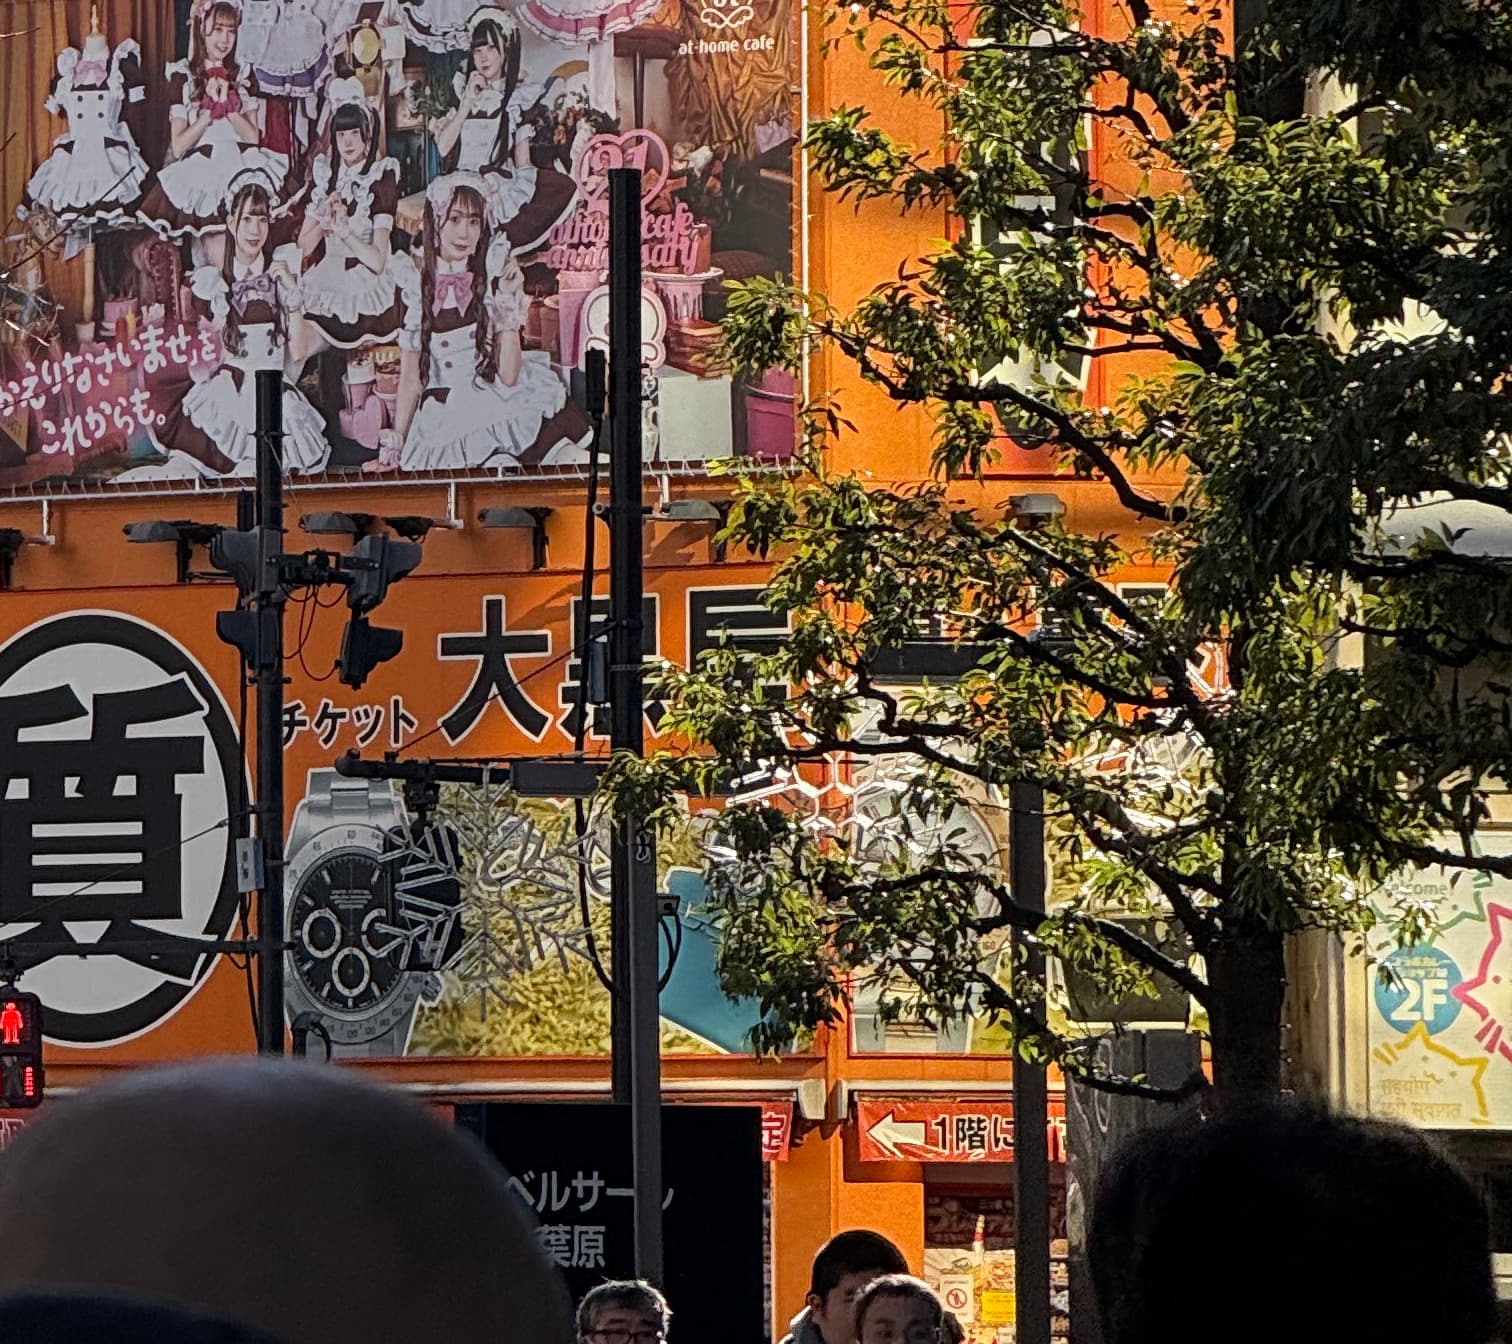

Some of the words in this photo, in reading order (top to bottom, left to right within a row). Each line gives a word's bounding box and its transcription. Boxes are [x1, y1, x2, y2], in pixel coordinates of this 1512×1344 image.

[678, 38, 740, 56] at-home
[742, 34, 776, 54] cafe
[41, 390, 167, 456] これからも。
[1390, 977, 1449, 1022] 2F
[505, 1169, 675, 1213] ベルサー
[531, 1223, 607, 1270] 葉原
